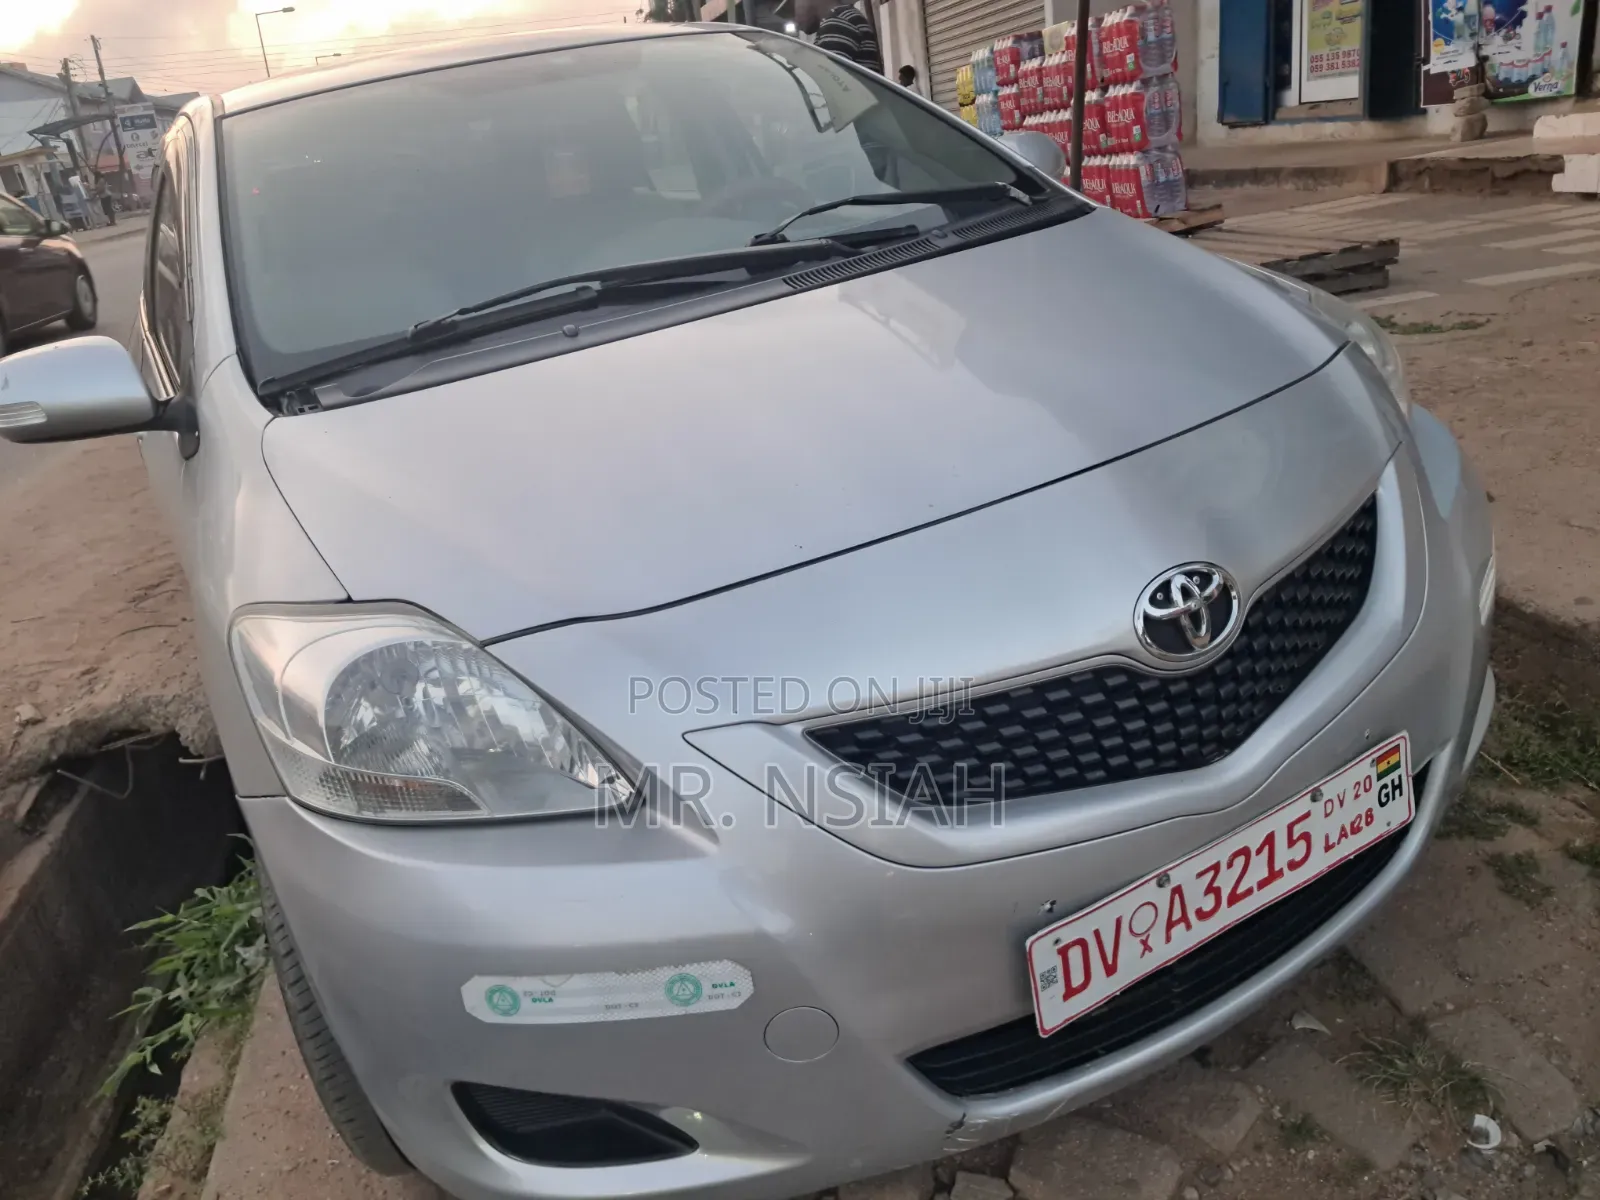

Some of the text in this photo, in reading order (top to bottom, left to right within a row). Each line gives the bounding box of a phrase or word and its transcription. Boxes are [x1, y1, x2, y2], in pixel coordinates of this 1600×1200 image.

[1310, 54, 1323, 64] 055
[1326, 52, 1340, 61] 135
[1310, 64, 1323, 73] 059
[1533, 81, 1558, 92] Verna
[1324, 775, 1372, 818] DV 20
[1378, 774, 1403, 808] GH
[1057, 916, 1122, 1002] DV
[1164, 810, 1312, 944] A3215
